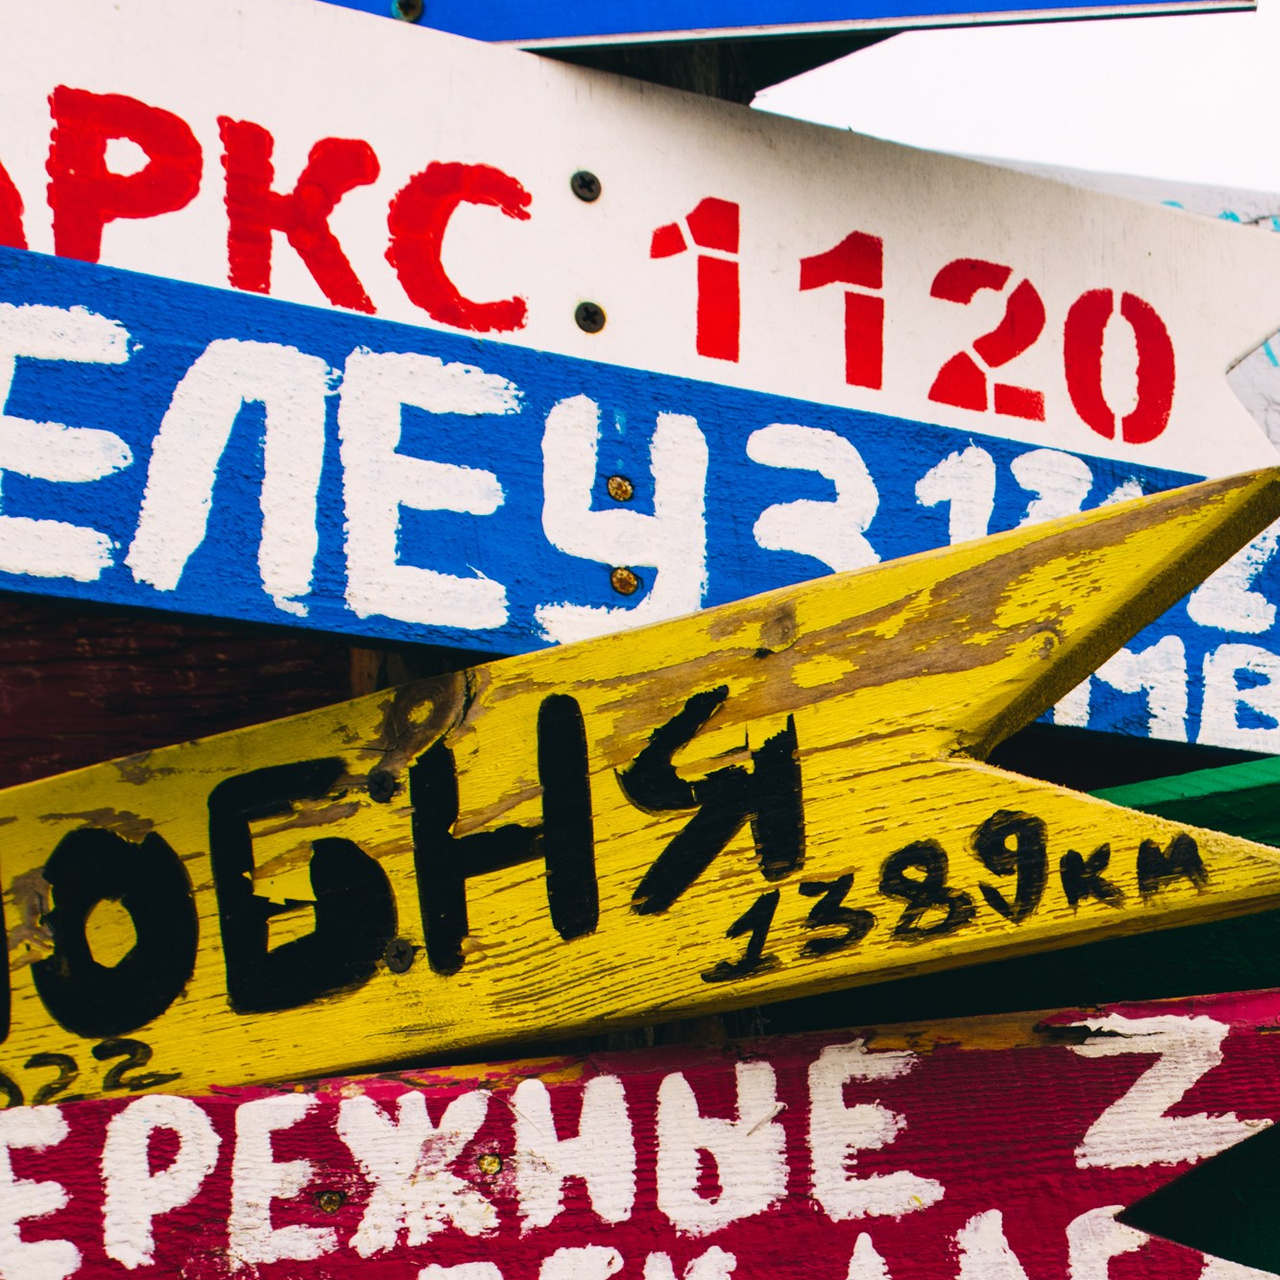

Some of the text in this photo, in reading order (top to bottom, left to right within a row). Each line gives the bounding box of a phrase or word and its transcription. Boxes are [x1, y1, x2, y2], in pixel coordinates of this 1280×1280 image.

[0, 85, 1176, 445] РКС 1120
[0, 684, 806, 1038] ОБНЯ
